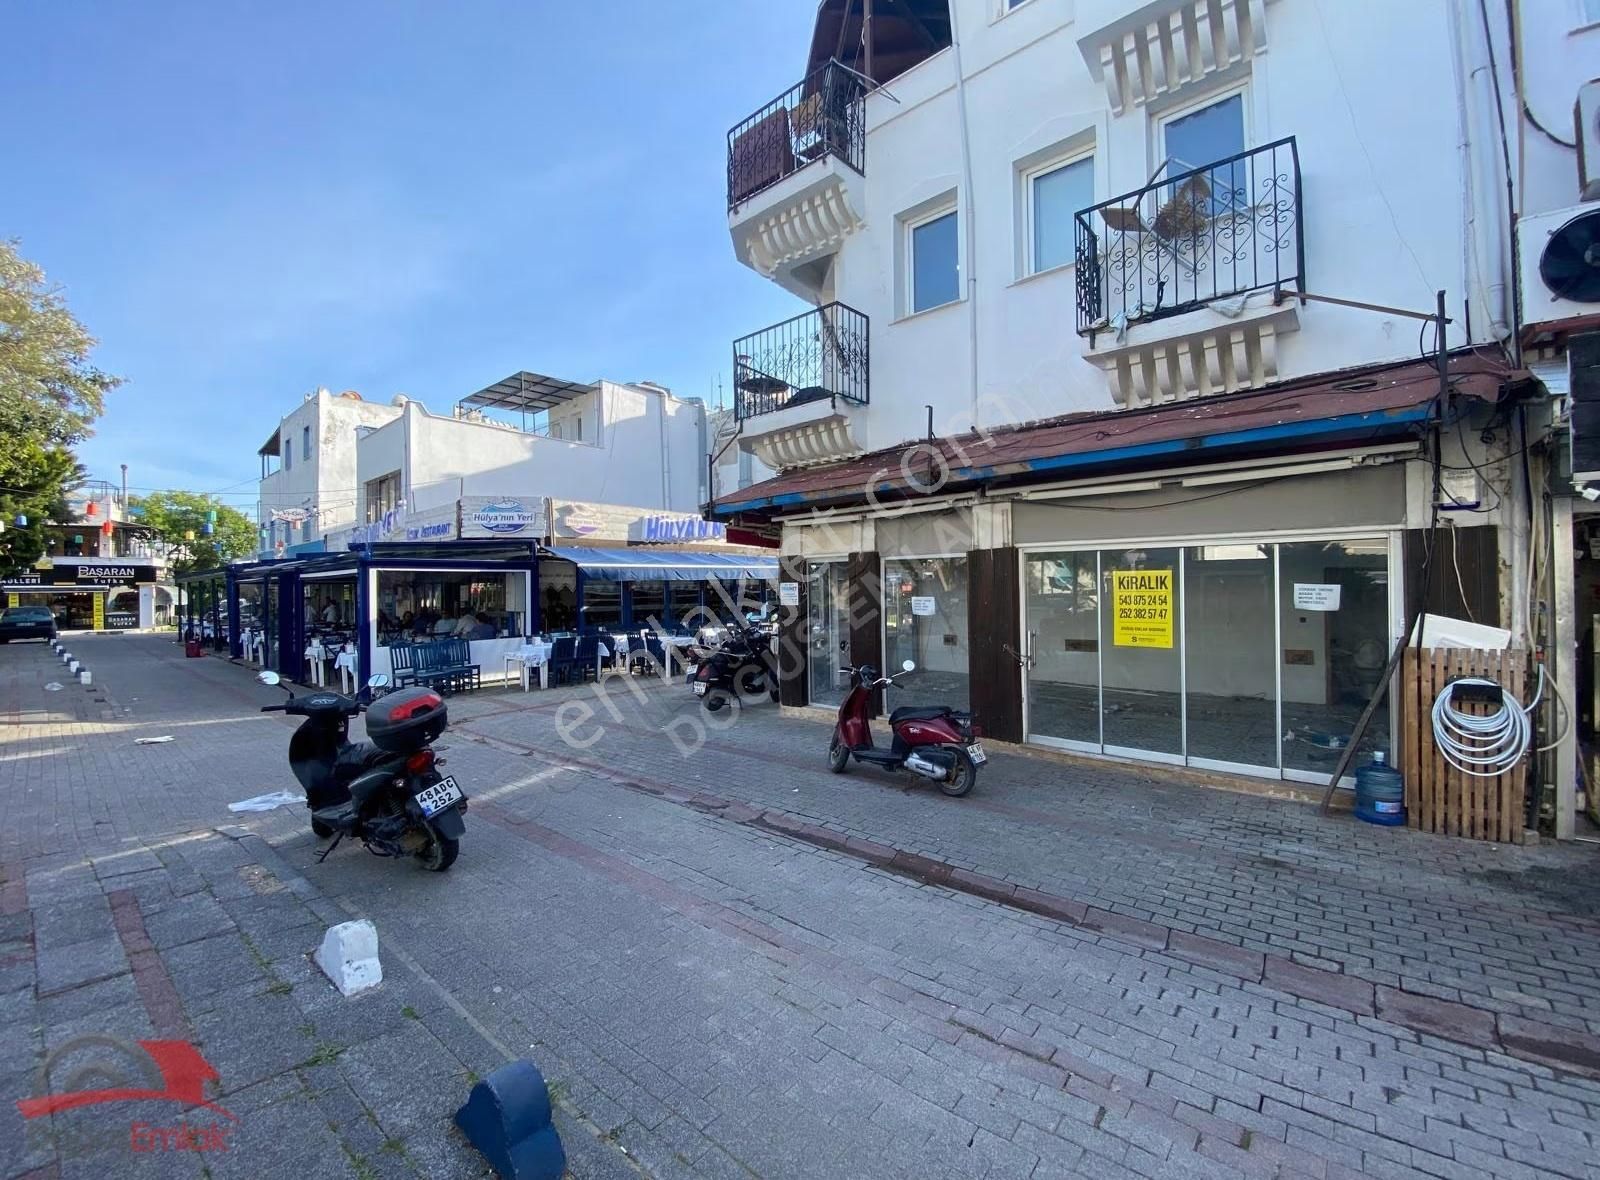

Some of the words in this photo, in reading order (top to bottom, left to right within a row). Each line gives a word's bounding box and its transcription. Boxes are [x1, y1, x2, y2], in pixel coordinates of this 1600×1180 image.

[517, 513, 533, 521] Yeri
[1119, 595, 1131, 605] 543
[1133, 595, 1146, 606] 875
[1148, 595, 1157, 605] 24
[1159, 595, 1168, 606] 54
[1120, 608, 1132, 618] 252
[1134, 608, 1146, 619] 382
[1148, 609, 1157, 619] 57
[1159, 609, 1168, 619] 47
[432, 792, 454, 809] 252
